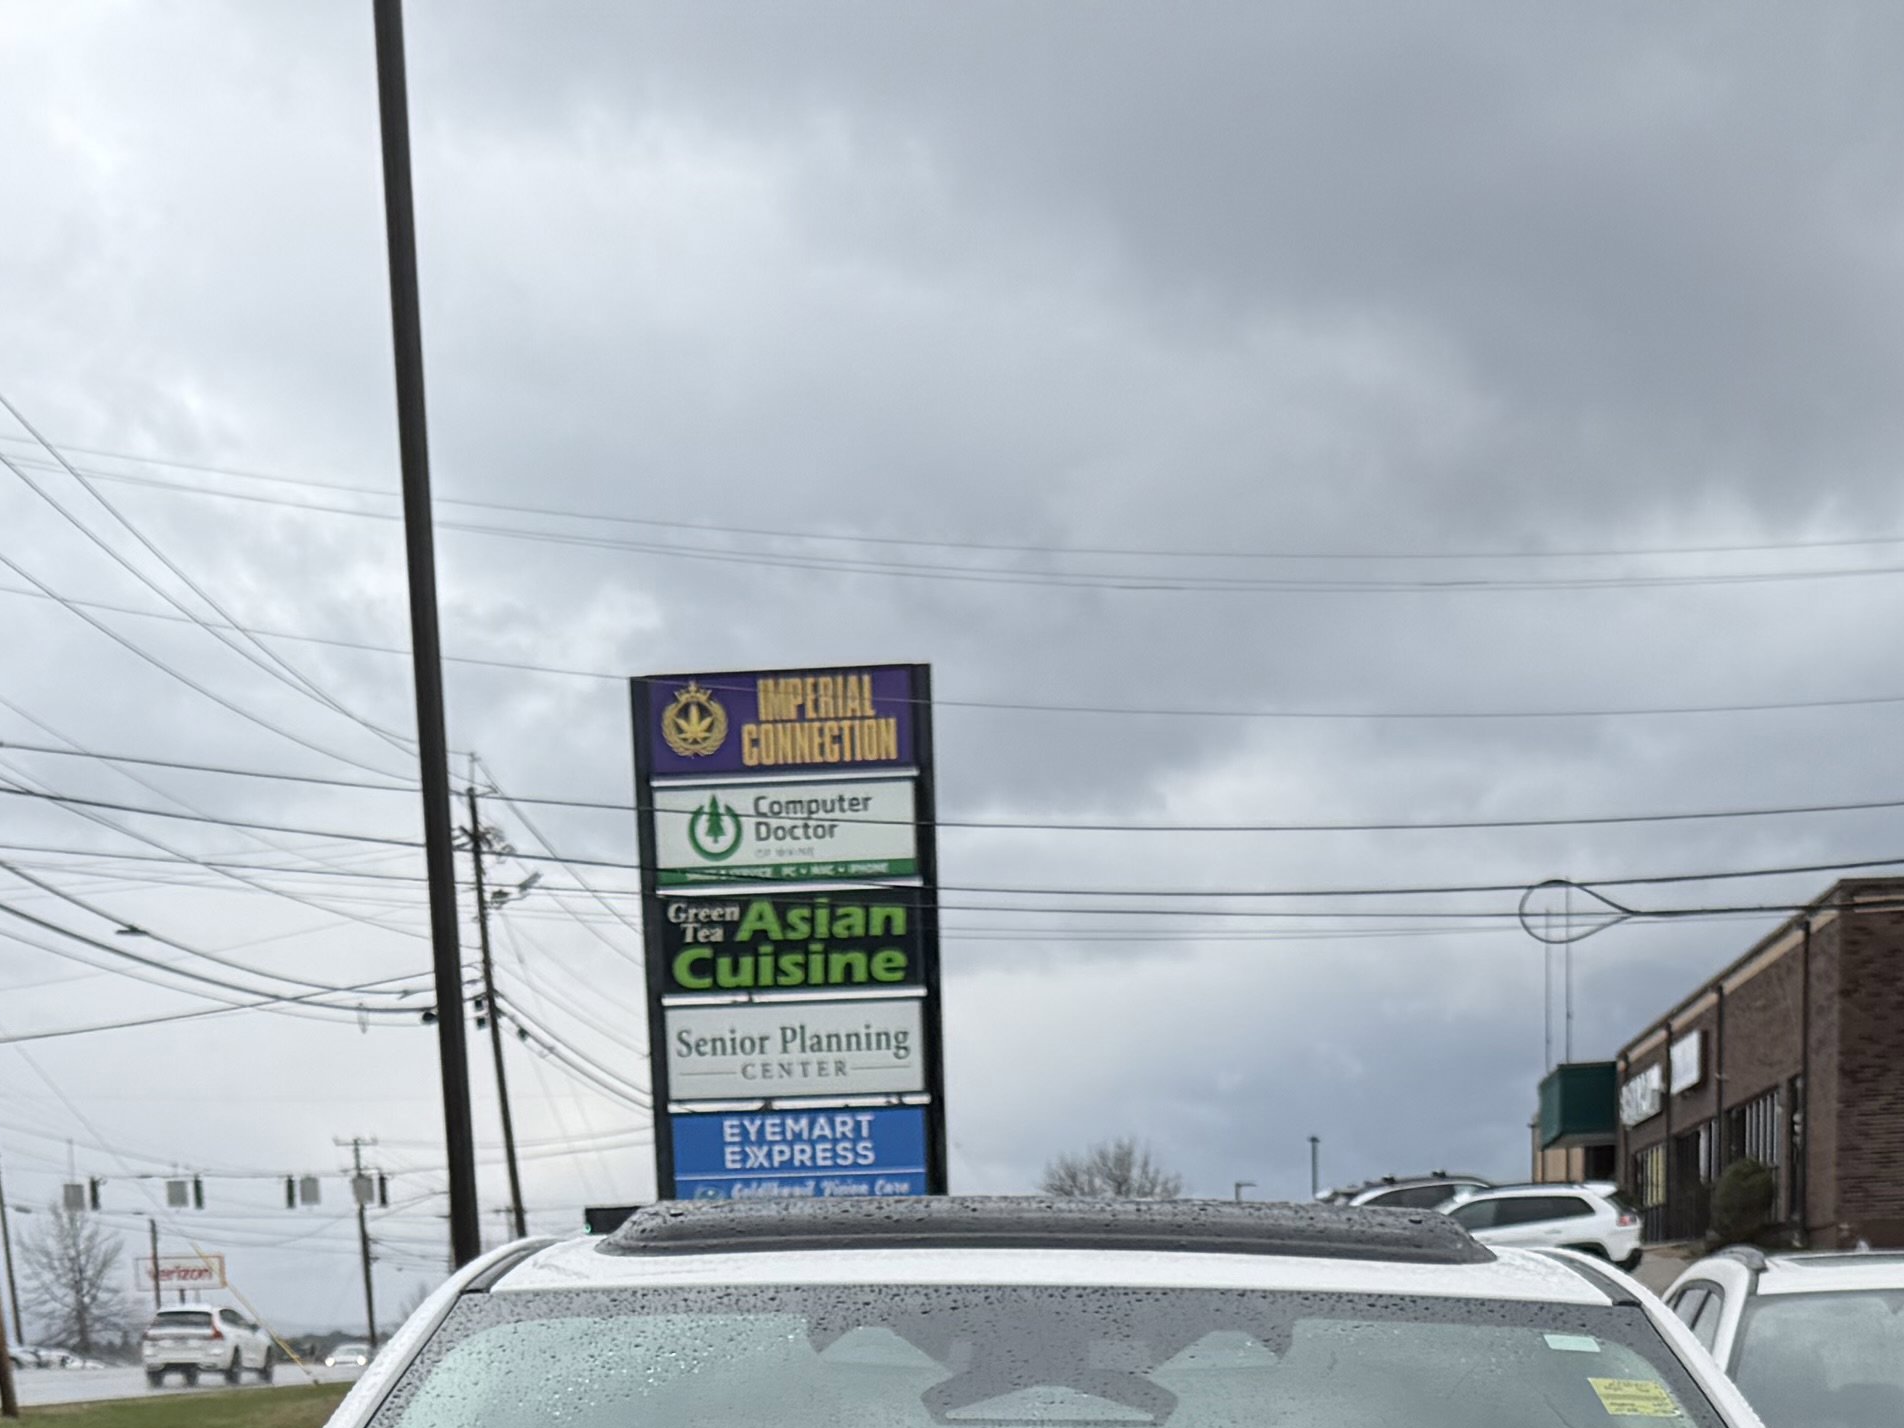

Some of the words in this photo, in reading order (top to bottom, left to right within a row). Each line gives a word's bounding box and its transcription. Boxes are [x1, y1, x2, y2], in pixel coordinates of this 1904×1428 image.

[757, 674, 876, 721] IMPERIAL
[741, 717, 898, 767] CONNECTION
[753, 794, 873, 818] Computer
[754, 821, 839, 842] Doctor
[667, 902, 740, 924] Green
[735, 898, 908, 942] Asian
[681, 923, 725, 943] Tea
[672, 943, 908, 989] Cuisine
[676, 1028, 771, 1058] Senior
[779, 1023, 911, 1060] Planning
[741, 1060, 850, 1081] CENTER
[723, 1113, 875, 1143] EYEMART
[724, 1143, 876, 1170] EXPRESS
